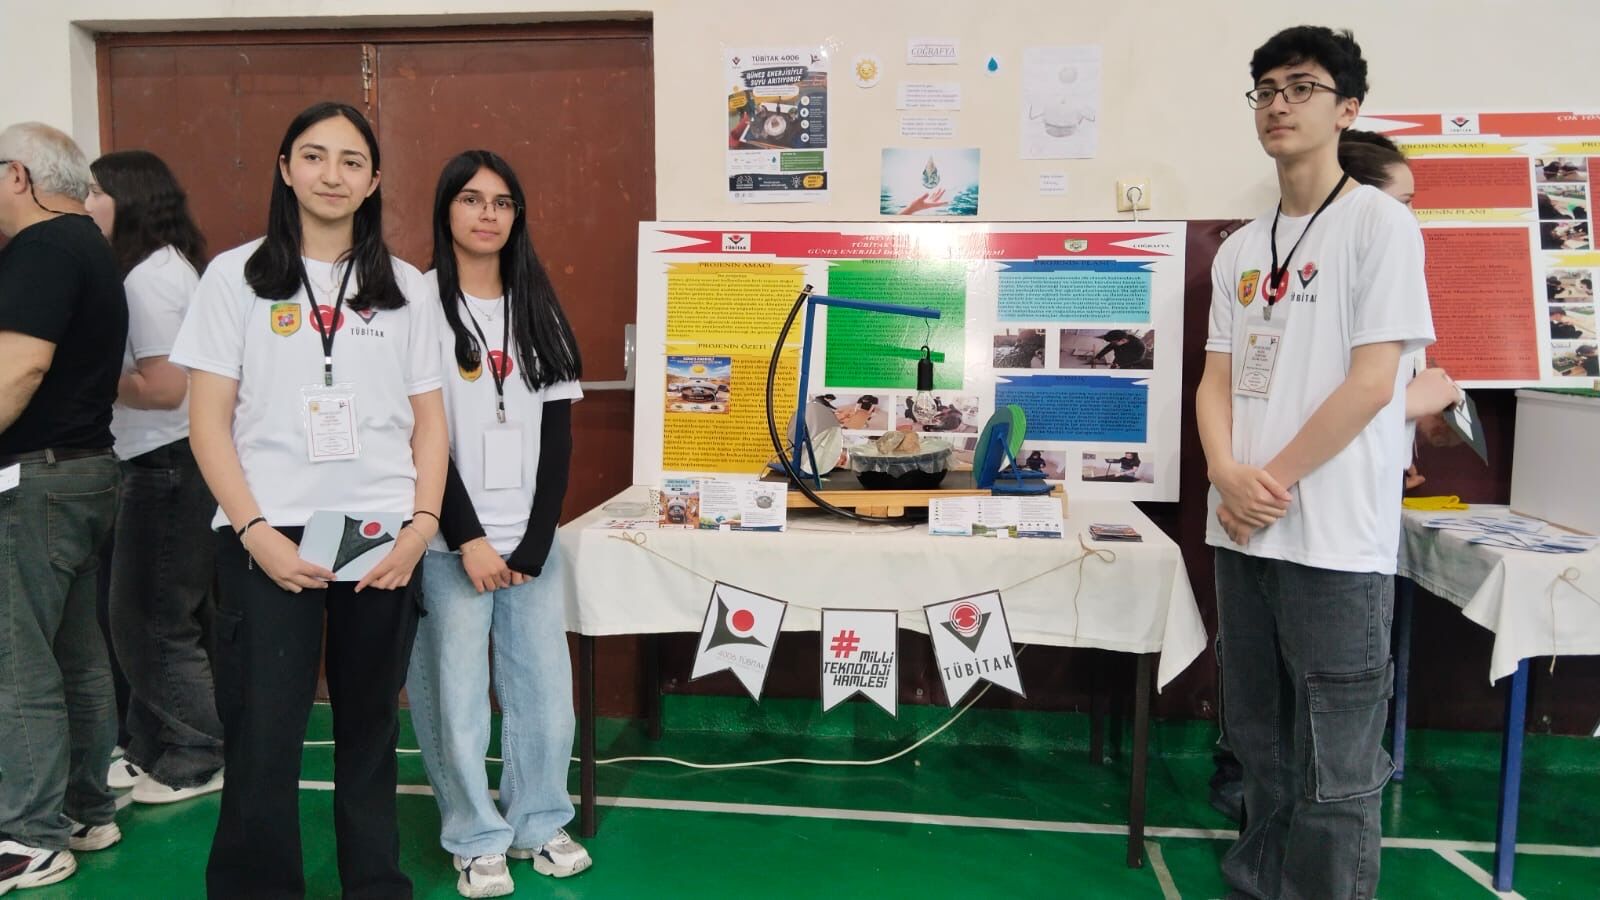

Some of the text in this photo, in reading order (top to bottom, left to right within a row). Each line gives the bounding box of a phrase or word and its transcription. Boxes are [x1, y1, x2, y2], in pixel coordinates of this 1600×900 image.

[911, 46, 956, 56] COĞRAFYA
[351, 327, 385, 338] TÜBİTAK
[944, 654, 1015, 681] TÜBİTAK
